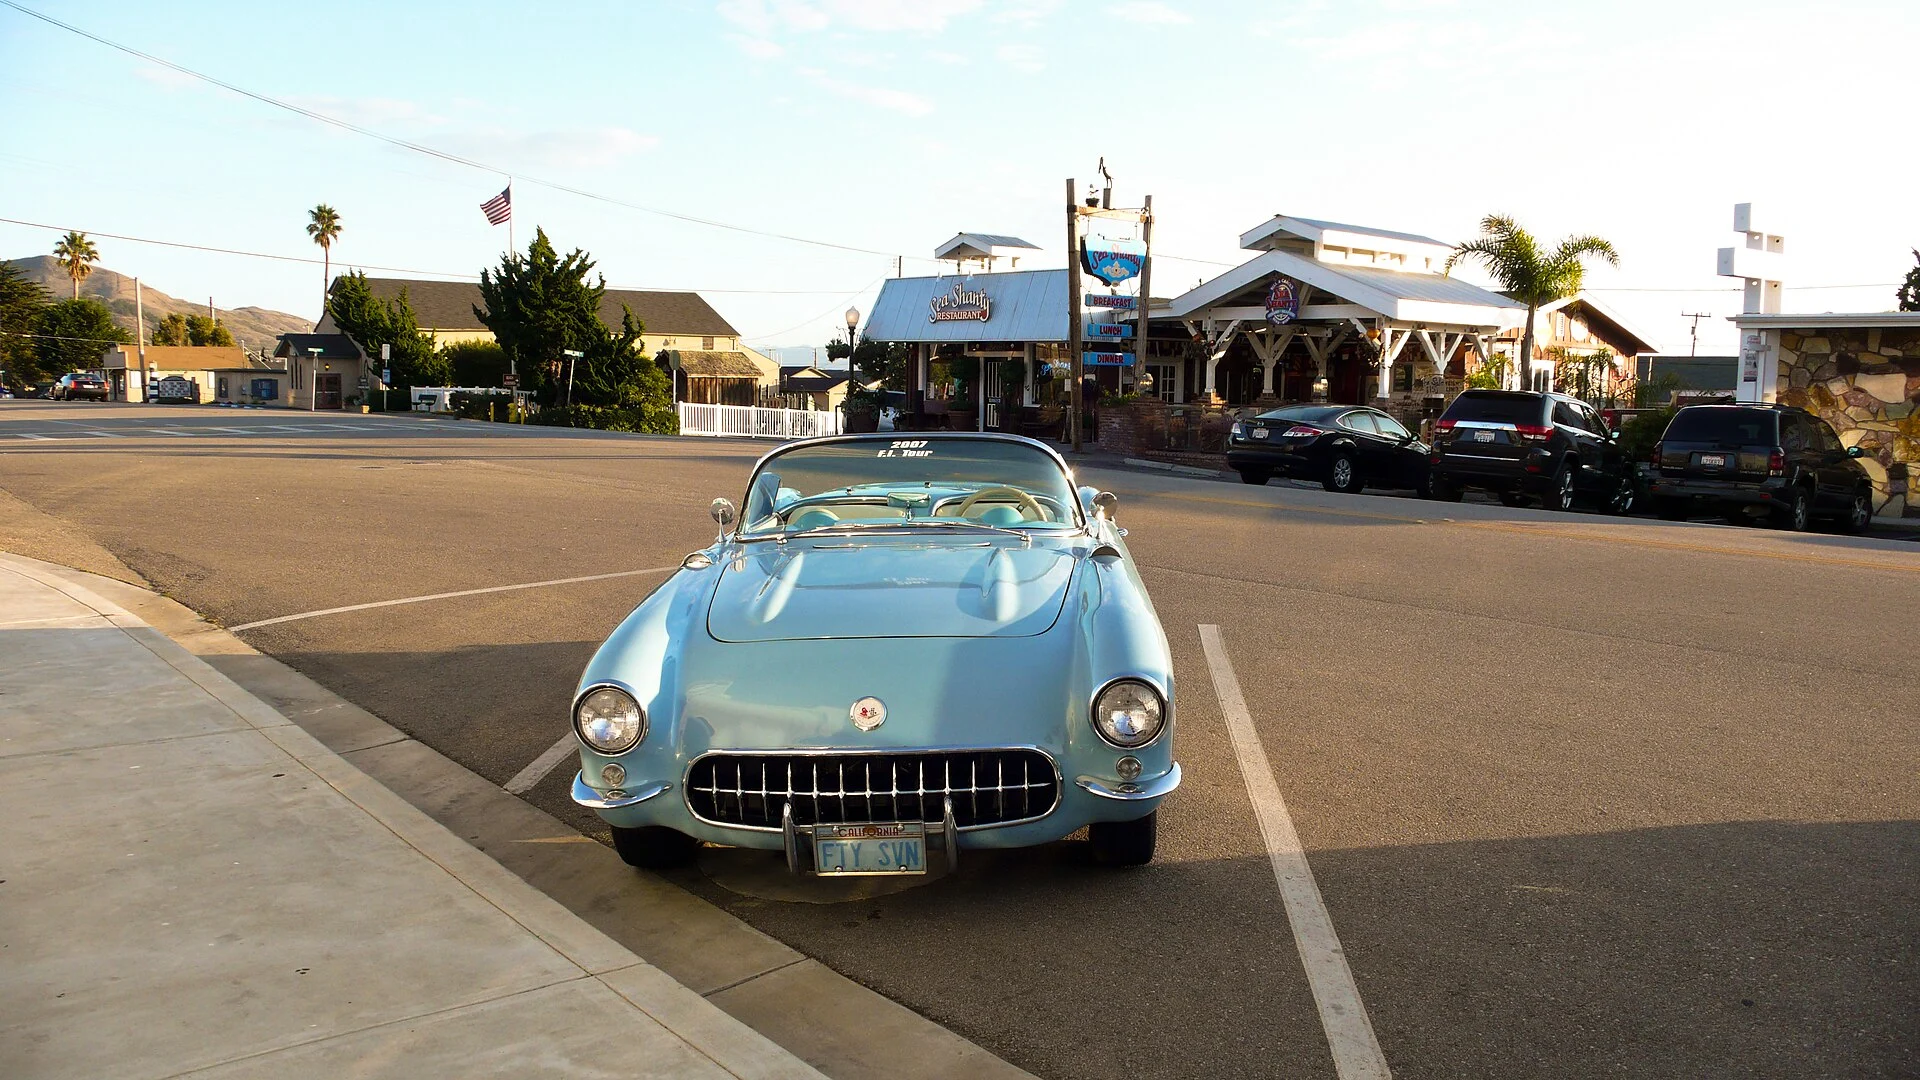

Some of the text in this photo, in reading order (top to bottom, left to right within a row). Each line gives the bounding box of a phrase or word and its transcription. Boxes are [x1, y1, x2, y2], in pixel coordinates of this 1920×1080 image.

[1092, 243, 1141, 277] Sea Shanty
[929, 282, 990, 323] Sea Shanty
[1093, 296, 1132, 307] BREAKFAST
[937, 311, 982, 320] RESTAURANT
[1100, 325, 1122, 335] LUNCH
[1097, 354, 1124, 363] DINNER
[902, 449, 933, 457] Tour
[839, 826, 899, 837] CALIFORNIA
[822, 841, 919, 867] FTY SVN
